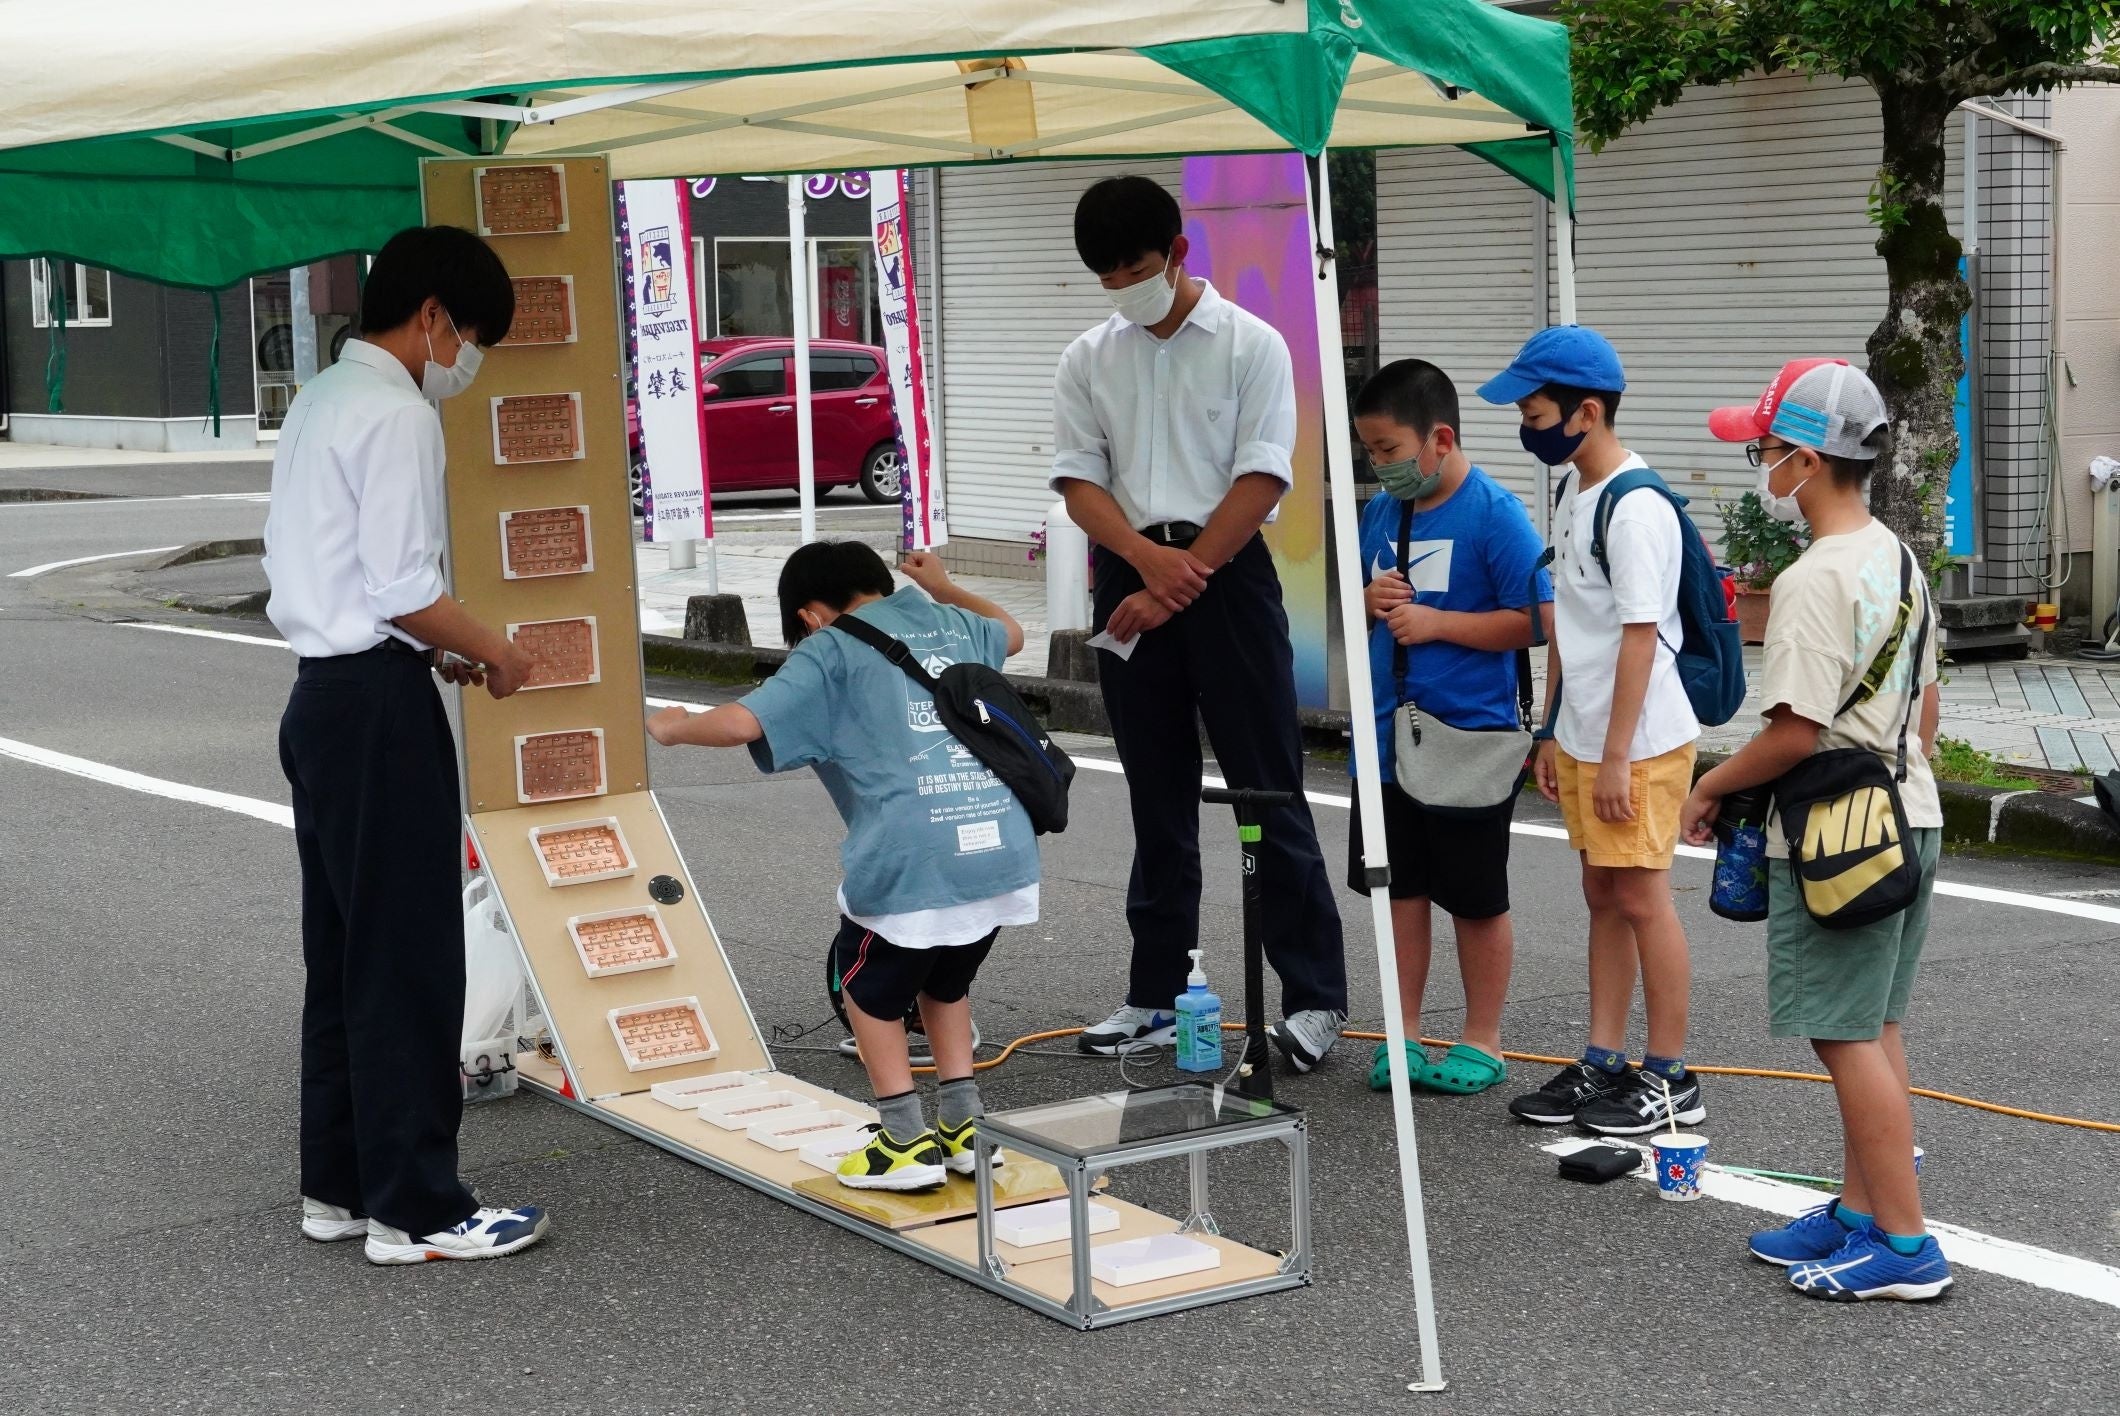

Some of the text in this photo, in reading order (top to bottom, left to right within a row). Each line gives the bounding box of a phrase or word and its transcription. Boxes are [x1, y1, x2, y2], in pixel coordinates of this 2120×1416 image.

[917, 776, 924, 786] IT
[926, 775, 933, 784] IS
[934, 774, 947, 783] NOT
[948, 773, 957, 782] IN
[957, 772, 969, 781] THE
[918, 786, 934, 796] OUR
[935, 783, 962, 794] DESTINY
[962, 781, 975, 791] BUT
[981, 777, 1005, 789] OURSEL
